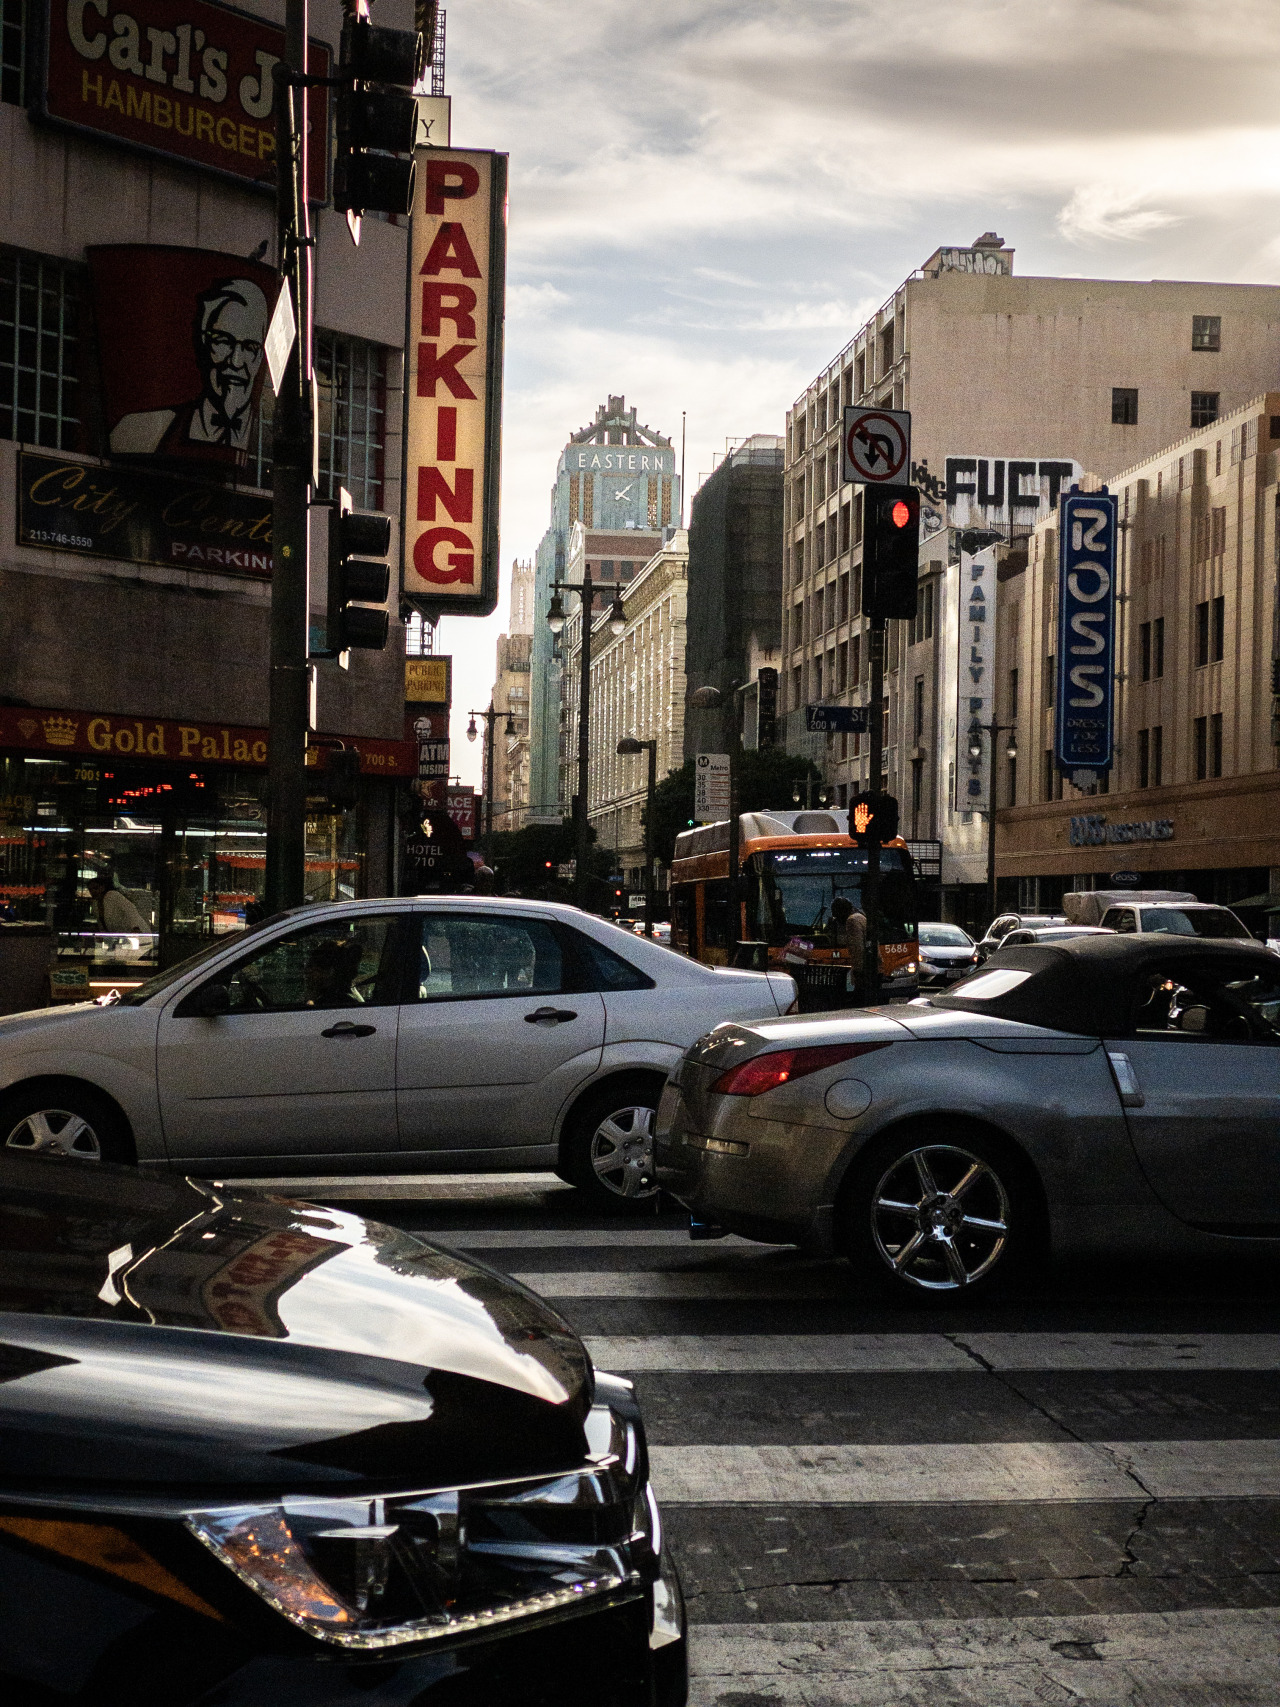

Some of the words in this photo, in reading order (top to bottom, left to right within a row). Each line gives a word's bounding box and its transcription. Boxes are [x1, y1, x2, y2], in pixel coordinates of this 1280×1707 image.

[66, 0, 229, 103] Carl's
[239, 48, 280, 119] J
[413, 159, 482, 586] PARKING
[578, 453, 664, 471] EASTERN
[945, 458, 1073, 507] FUCT
[29, 466, 138, 534] City
[162, 489, 273, 543] Cente
[29, 529, 93, 548] 213-746-5550
[171, 542, 273, 570] PARKIN
[1068, 507, 1110, 708] ROSS
[968, 564, 986, 683] FAMILY
[409, 664, 444, 677] PUBLIC
[407, 680, 444, 692] PARKING
[851, 709, 865, 722] St
[810, 720, 827, 730] 200
[830, 721, 837, 730] W
[1067, 717, 1105, 728] DRESS
[86, 717, 167, 757] Gold
[178, 725, 268, 763] Palac
[421, 744, 449, 761] ATM
[1070, 743, 1101, 753] LESS
[366, 753, 388, 766] 700
[74, 768, 94, 781] 700
[420, 763, 449, 775] INSIDE
[406, 844, 444, 856] HOTEL
[414, 857, 435, 867] 710
[1115, 873, 1138, 882] ROSS
[884, 944, 908, 954] 5686
